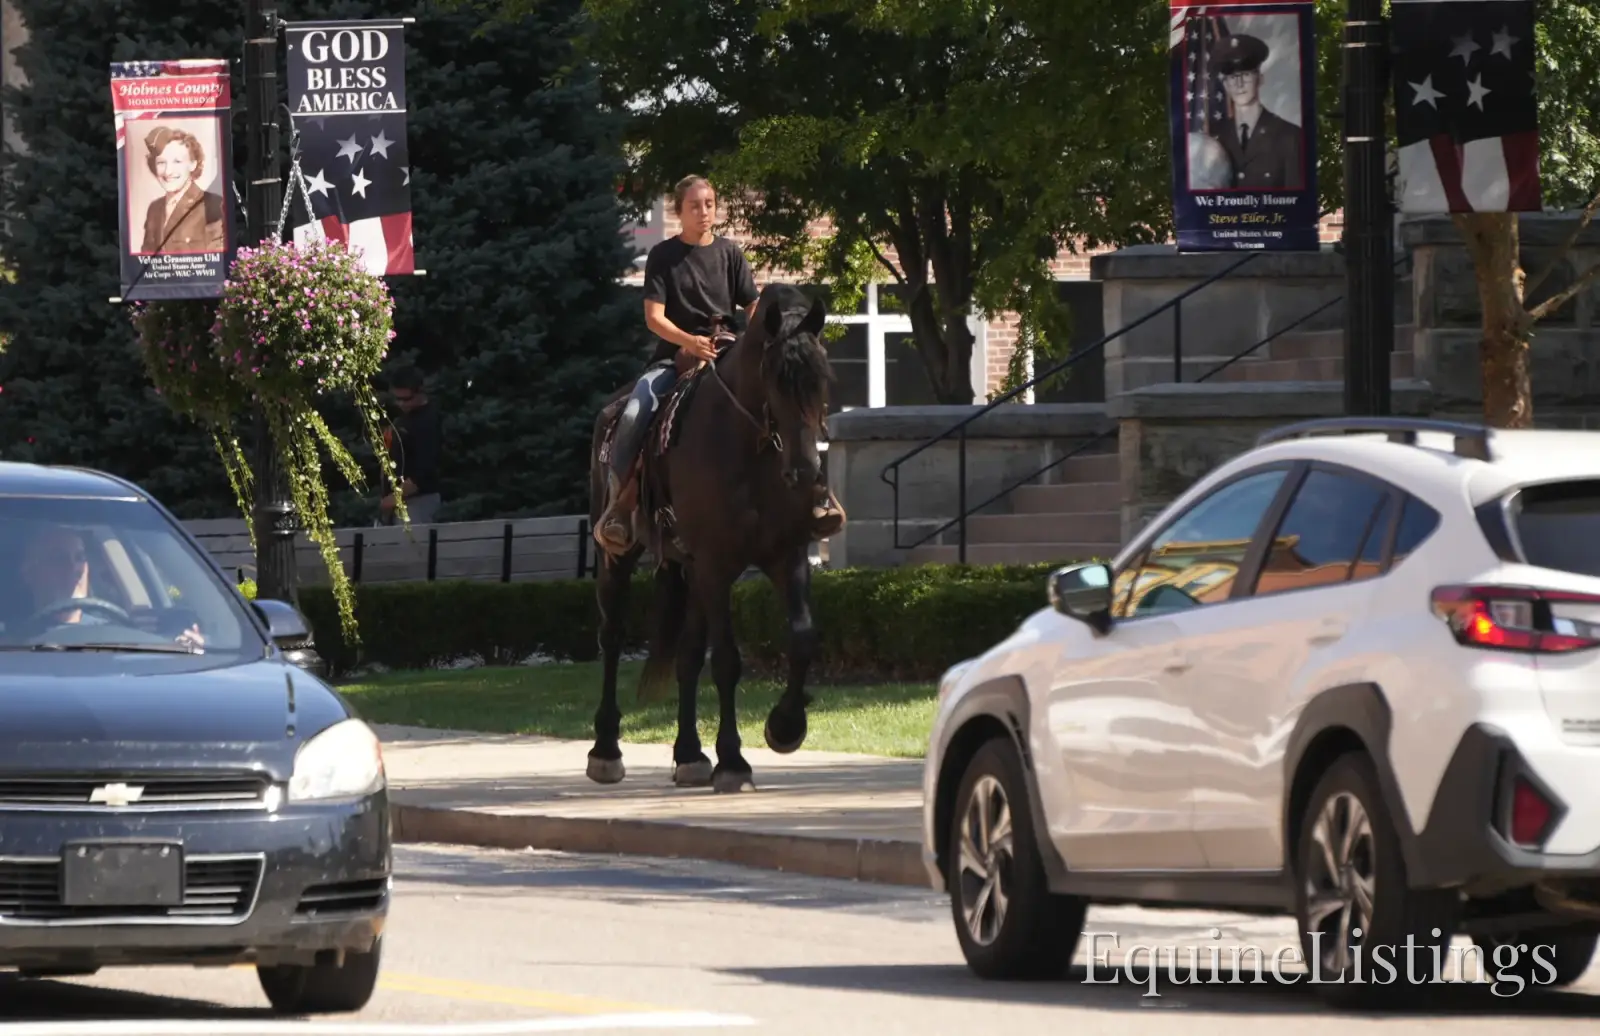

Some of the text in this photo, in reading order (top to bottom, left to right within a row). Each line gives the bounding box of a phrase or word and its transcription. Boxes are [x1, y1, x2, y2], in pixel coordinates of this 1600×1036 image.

[302, 30, 389, 63] GOD
[307, 66, 387, 90] BLESS
[119, 81, 224, 98] Holmes County
[128, 97, 180, 106] HOMETOWN
[297, 91, 398, 112] AMERICA
[1195, 194, 1298, 208] We Proudly Honor
[1209, 213, 1238, 224] Steve
[1271, 212, 1287, 224] Jr.
[1212, 230, 1283, 239] United States Army
[1233, 241, 1265, 249] Vietnam
[138, 255, 162, 265] Velma
[152, 263, 172, 271] United
[190, 262, 207, 270] Army
[143, 271, 153, 279] Air
[153, 271, 171, 280] Corps
